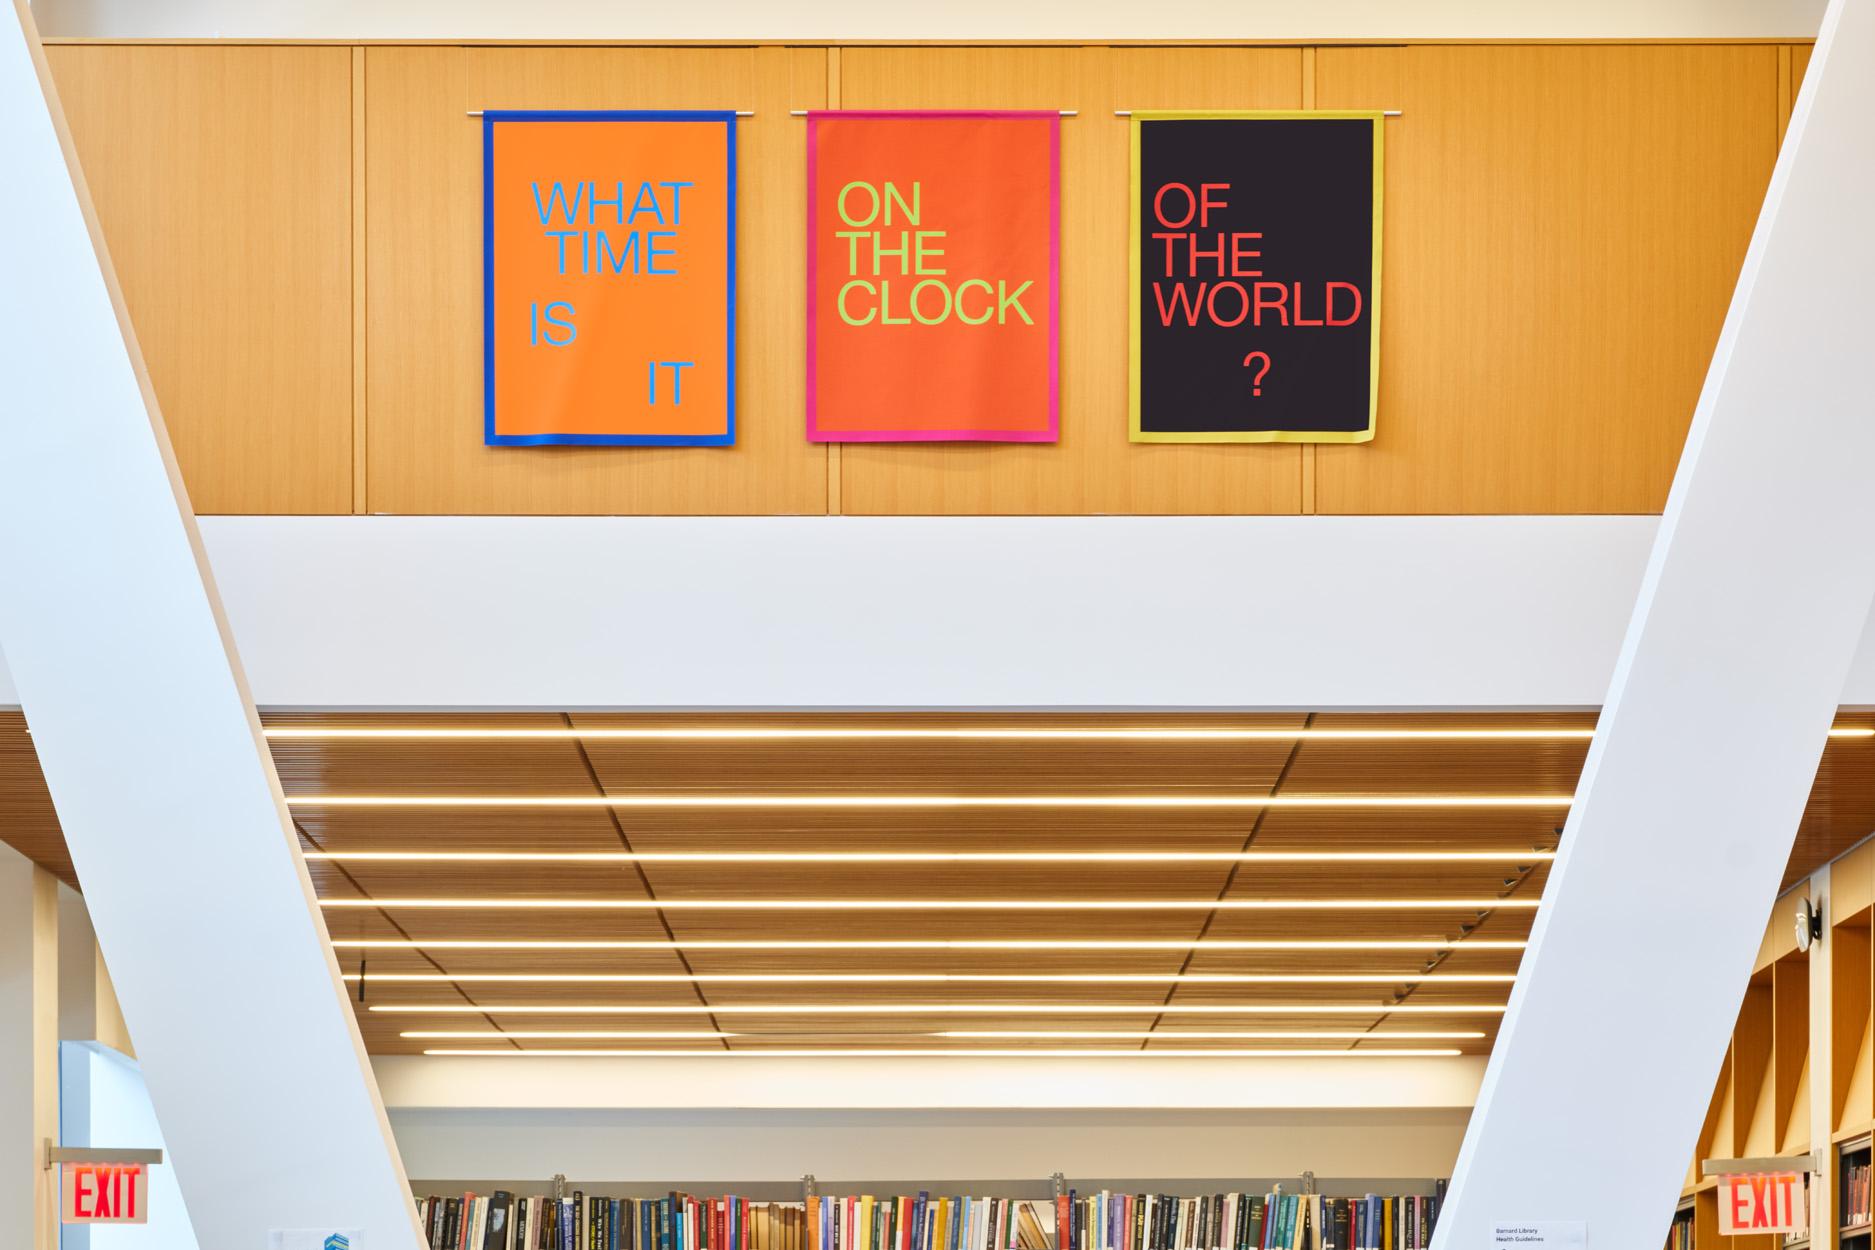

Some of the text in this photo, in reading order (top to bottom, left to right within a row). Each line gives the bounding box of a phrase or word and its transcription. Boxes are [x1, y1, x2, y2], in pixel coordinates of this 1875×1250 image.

[532, 182, 693, 225] WHAT
[838, 181, 919, 227] ON
[1154, 183, 1230, 228] OF
[545, 231, 677, 274] TIME
[836, 231, 946, 275] THE
[1152, 233, 1262, 277] THE
[532, 302, 576, 346] IS
[838, 279, 1034, 325] CLOCK
[1153, 281, 1361, 327] WORLD
[650, 362, 694, 405] IT
[1244, 351, 1270, 396] ?
[75, 1168, 140, 1218] EXIT
[1730, 1176, 1796, 1228] EXIT
